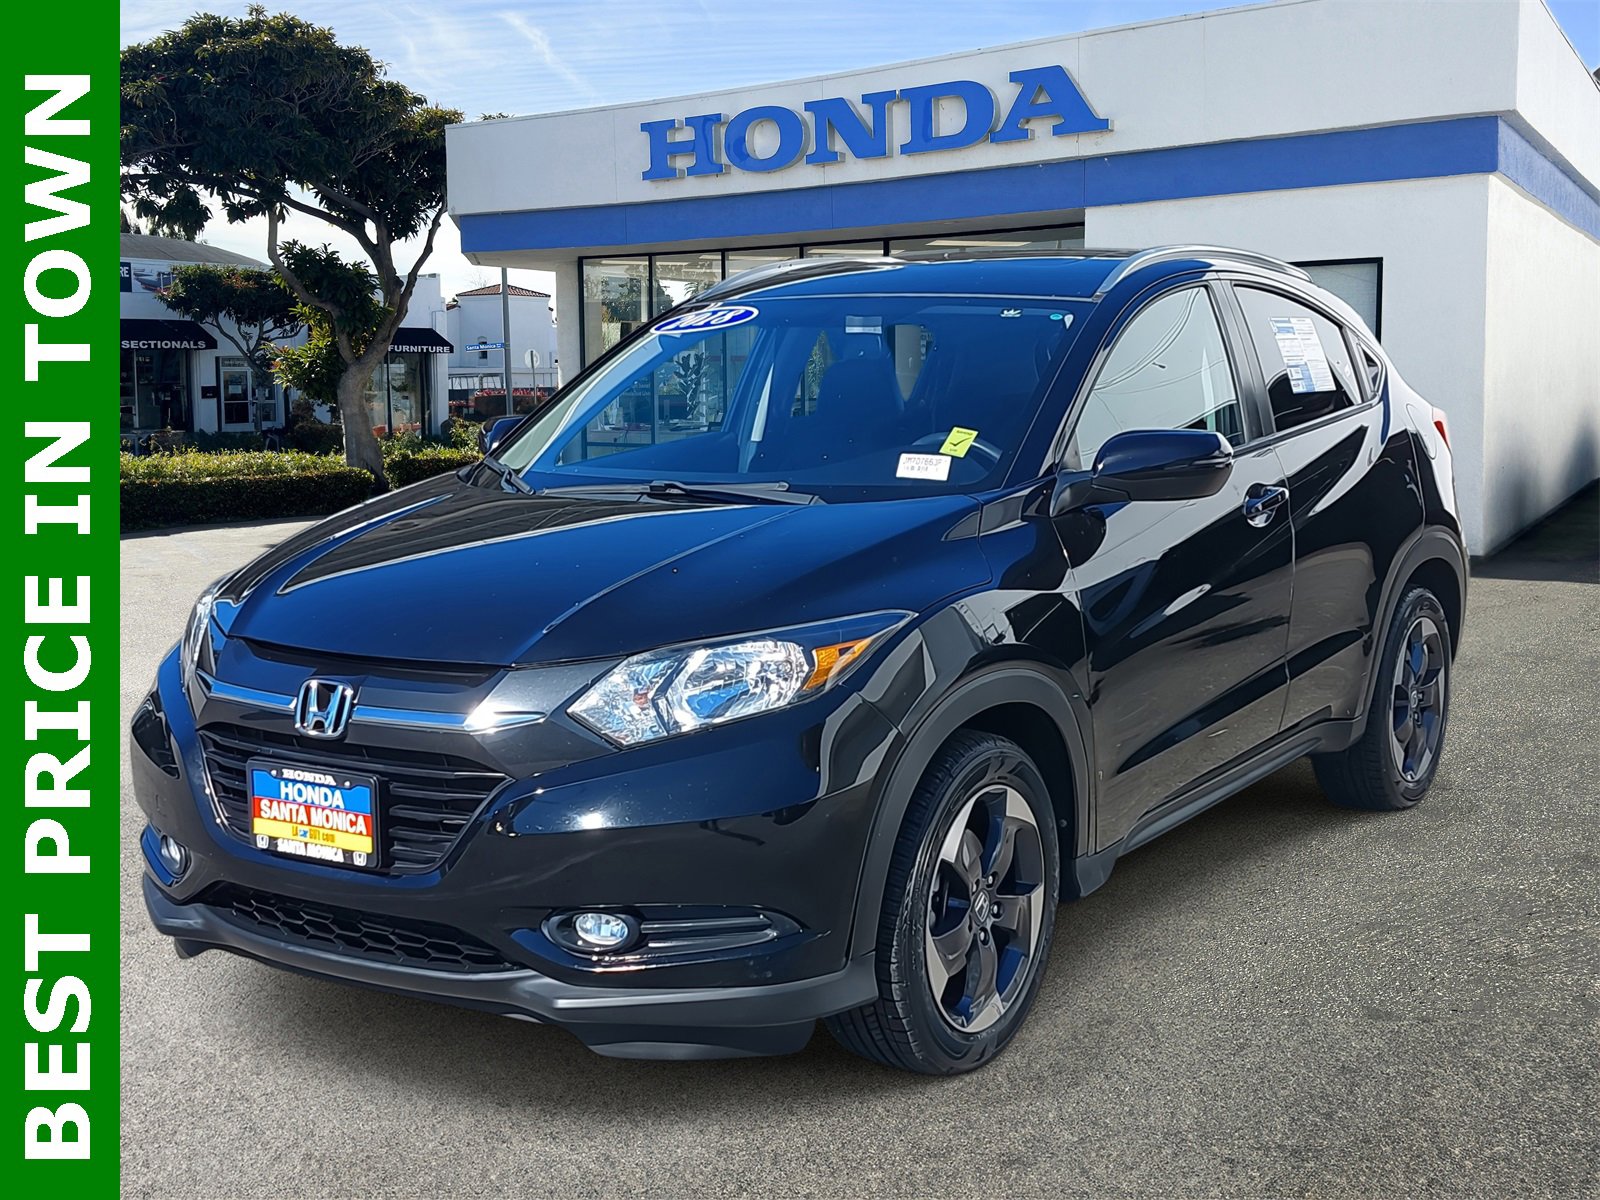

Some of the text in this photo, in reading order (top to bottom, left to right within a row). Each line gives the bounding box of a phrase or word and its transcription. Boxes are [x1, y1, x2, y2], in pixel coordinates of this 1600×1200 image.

[640, 65, 1112, 182] HONDA
[121, 340, 206, 349] SECTIONALS
[388, 345, 451, 353] FURNITURE
[282, 768, 336, 786] HONDA
[280, 781, 345, 809] HONDA
[260, 800, 367, 836] SANTA MONICA
